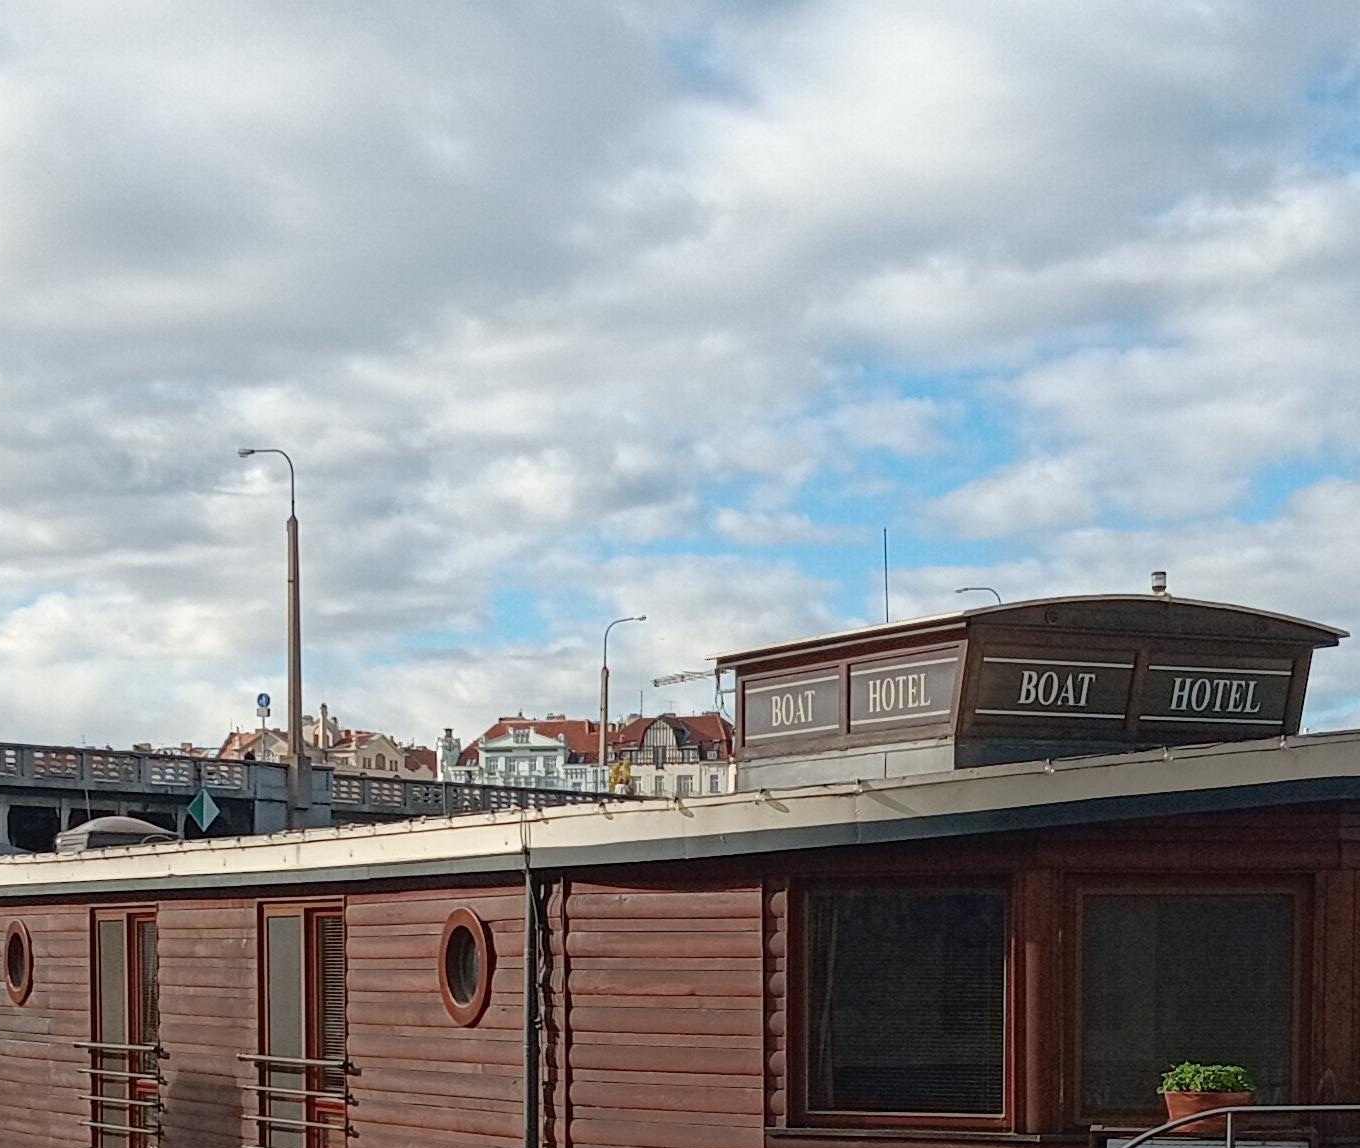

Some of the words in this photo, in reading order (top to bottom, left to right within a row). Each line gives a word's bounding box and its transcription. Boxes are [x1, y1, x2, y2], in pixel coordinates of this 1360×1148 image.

[771, 689, 816, 727] BOAT
[867, 673, 931, 713] HOTEL
[1017, 670, 1096, 707] BOAT
[1168, 677, 1262, 714] HOTEL
